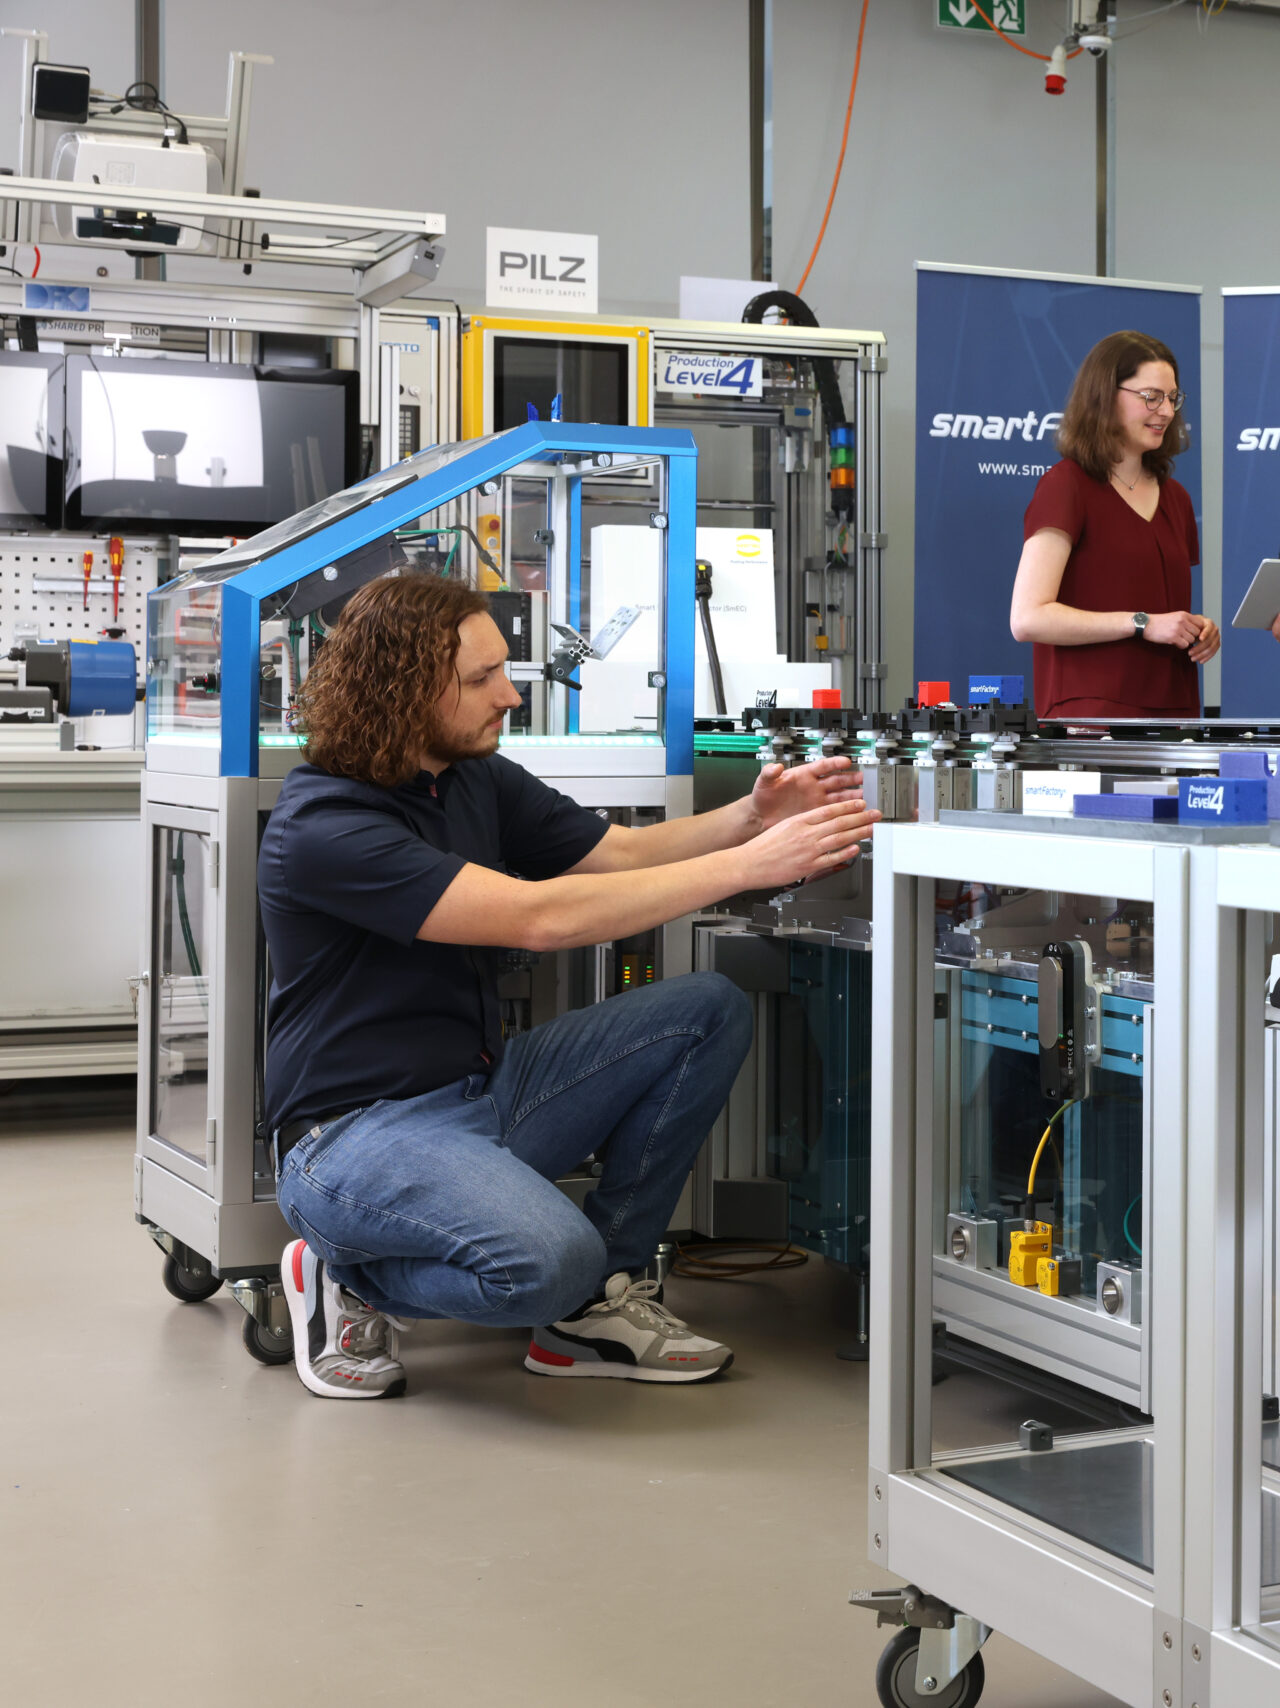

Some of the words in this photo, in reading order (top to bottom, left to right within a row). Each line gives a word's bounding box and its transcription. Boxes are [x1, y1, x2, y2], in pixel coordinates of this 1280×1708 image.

[499, 250, 587, 284] PILZ
[499, 285, 514, 293] THE
[517, 286, 543, 295] SPIRIT
[545, 288, 555, 296] OF
[557, 289, 587, 298] SAFETY
[47, 320, 86, 333] SHARED
[667, 354, 735, 369] Production
[1189, 784, 1217, 795] Production
